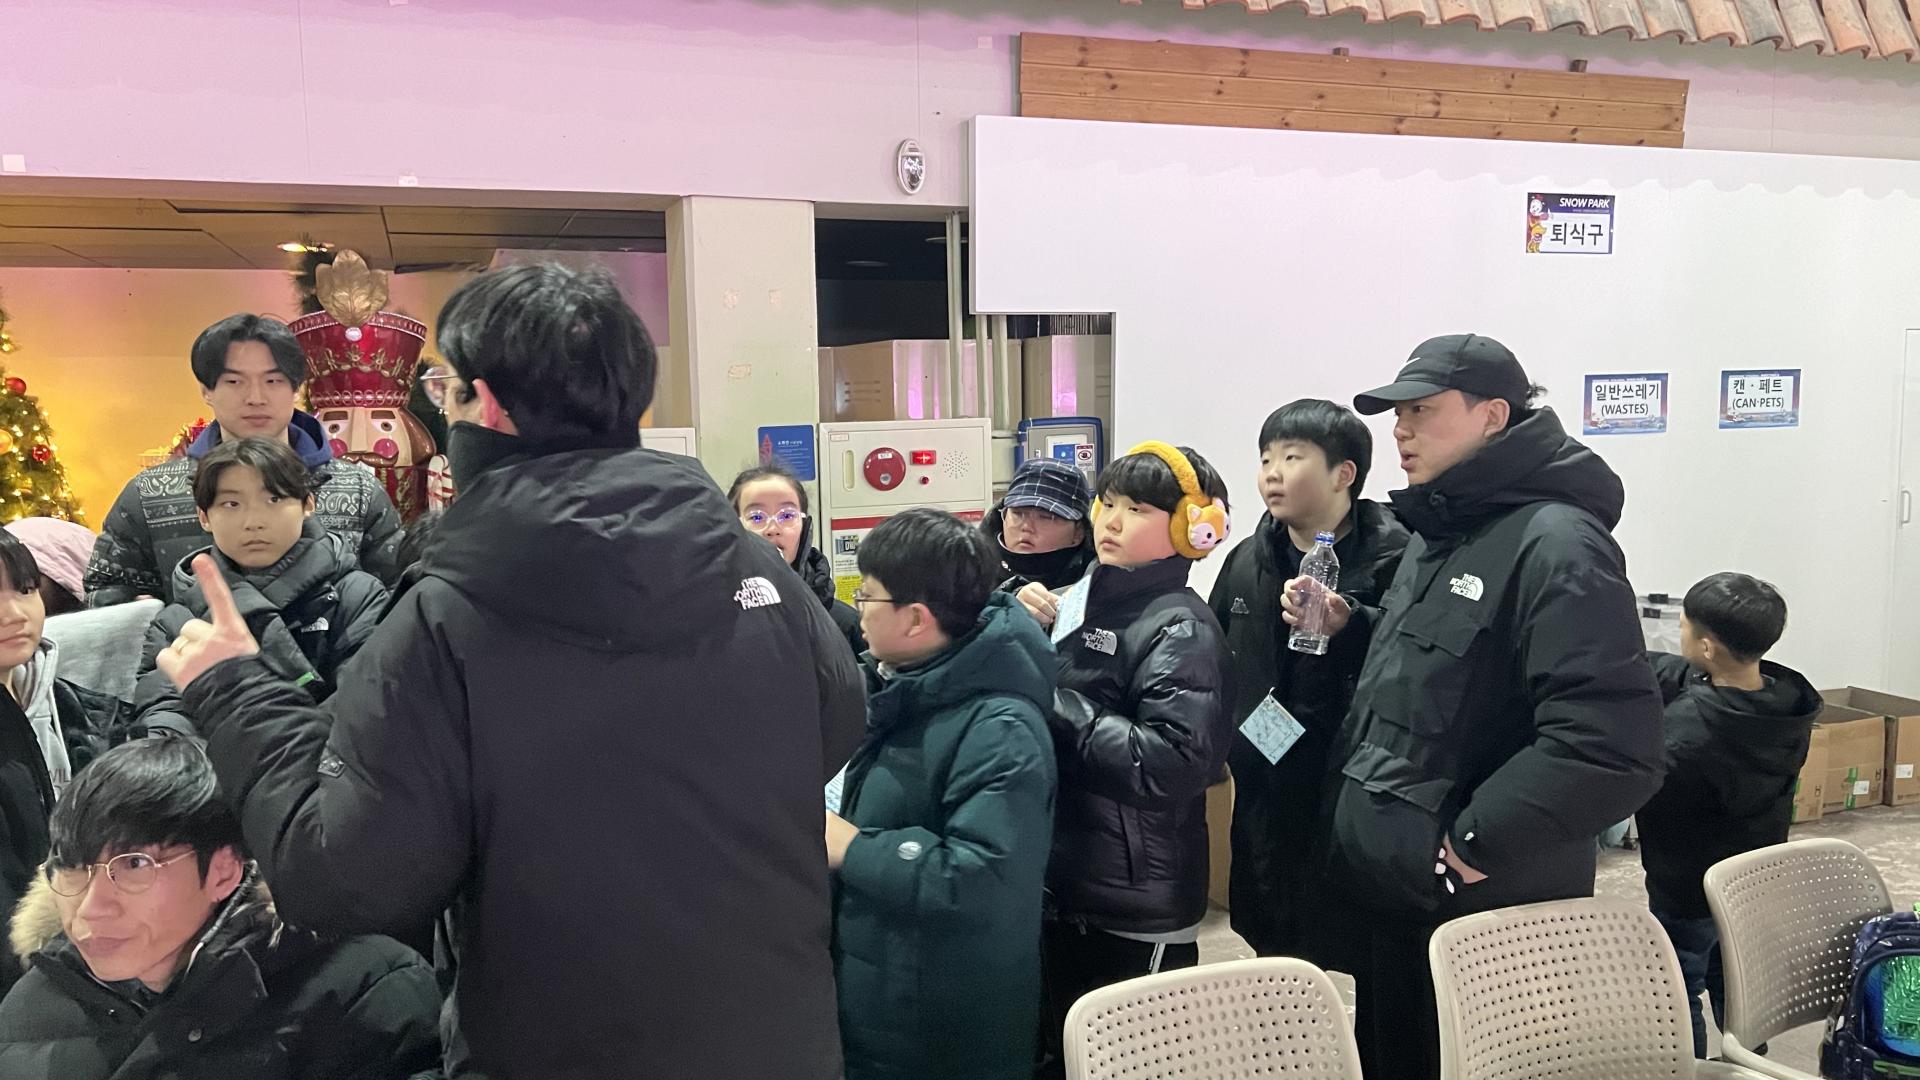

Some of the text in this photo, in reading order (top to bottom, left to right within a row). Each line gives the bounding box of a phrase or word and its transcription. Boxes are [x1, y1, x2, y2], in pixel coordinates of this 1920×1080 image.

[1559, 197, 1610, 209] SNOW PARK
[1550, 222, 1604, 246] 퇴식구
[1595, 383, 1659, 401] 일반쓰레기
[1733, 378, 1745, 395] 캔
[1758, 378, 1783, 394] 페트
[1601, 403, 1649, 417] (WASTES)
[741, 578, 760, 592] THE
[741, 596, 766, 610] FACE
